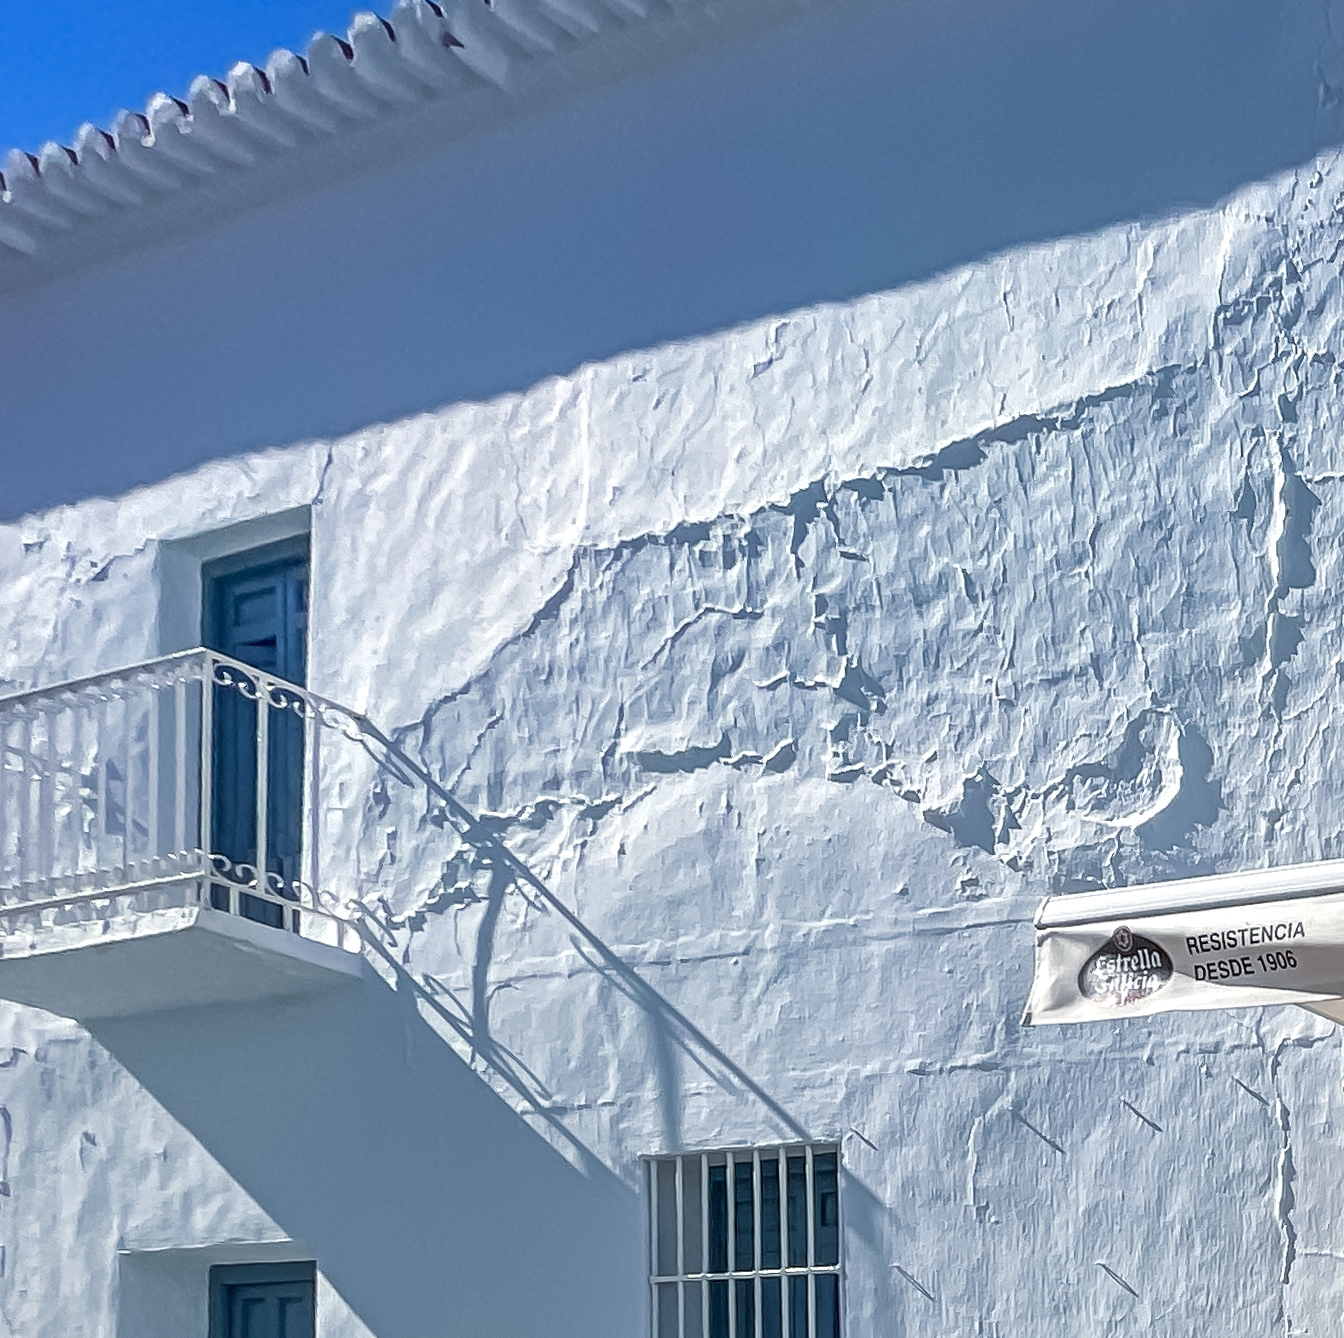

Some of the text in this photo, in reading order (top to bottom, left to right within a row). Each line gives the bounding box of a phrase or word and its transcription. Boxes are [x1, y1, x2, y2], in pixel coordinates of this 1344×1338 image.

[1185, 921, 1306, 956] RESISTENCIA
[1096, 949, 1162, 974] Estrella
[1193, 950, 1298, 982] DESDE 1906
